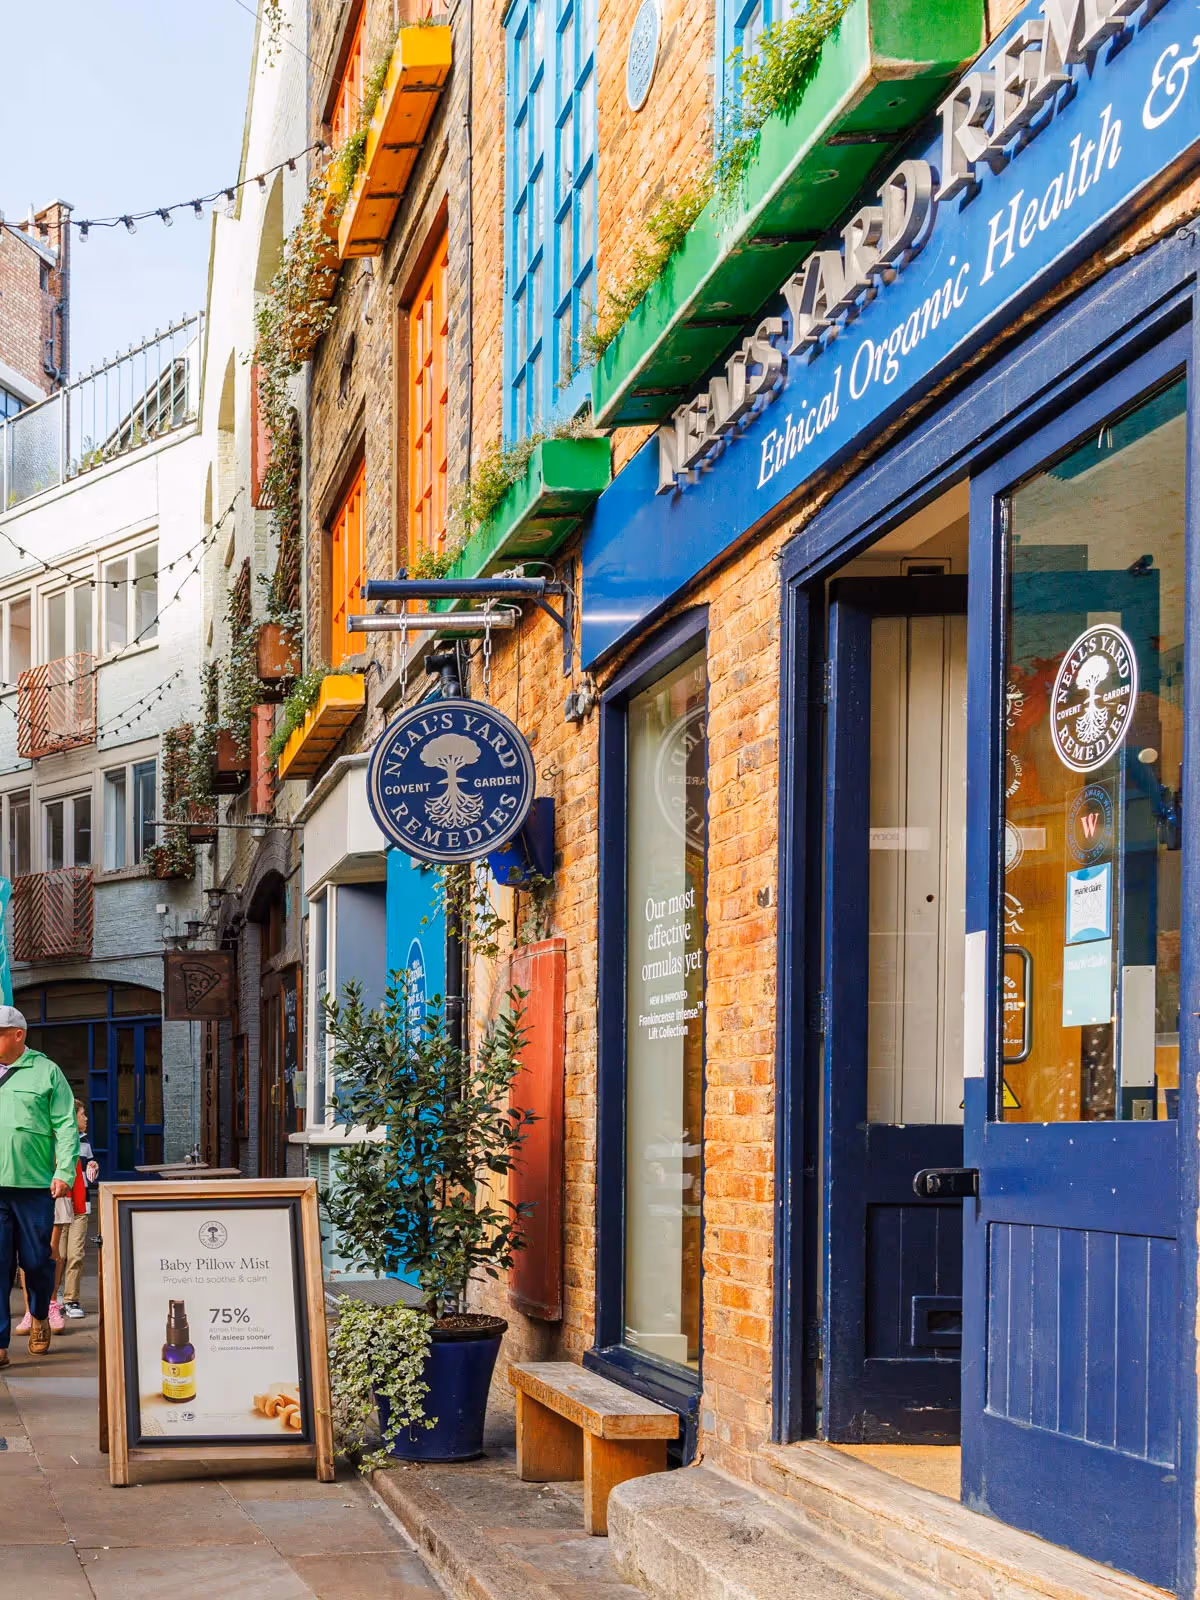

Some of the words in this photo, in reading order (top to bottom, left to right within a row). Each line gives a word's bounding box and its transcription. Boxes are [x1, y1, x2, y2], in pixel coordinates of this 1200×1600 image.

[655, 316, 783, 496] NEAL'S
[780, 160, 931, 356] YARD
[934, 0, 1145, 201] REM
[756, 365, 843, 490] Ethical
[849, 255, 970, 401] Organic
[980, 102, 1123, 286] Health
[1142, 35, 1200, 130] &
[1058, 637, 1097, 704] NEAL'S
[1101, 635, 1130, 678] YARD
[1057, 705, 1082, 721] COVENT
[1102, 684, 1130, 703] GARDEN
[384, 712, 454, 777] NEAL'S
[463, 715, 518, 769] YARD
[1058, 704, 1127, 762] REMEDIES
[384, 783, 431, 796] COVENT
[473, 775, 521, 788] GARDEN
[391, 793, 517, 848] REMEDIES
[1081, 812, 1099, 839] W
[645, 897, 666, 922] Our
[668, 887, 696, 915] most
[1074, 886, 1088, 896] marie
[648, 918, 691, 951] effective
[641, 951, 683, 981] ormulas
[684, 948, 703, 978] yet
[664, 990, 688, 1003] IMPROVED
[639, 1012, 675, 1027] Frankincense
[648, 1027, 658, 1040] Lift
[659, 1024, 688, 1039] Collection
[160, 1258, 192, 1272] Baby
[196, 1258, 236, 1270] Pillow
[240, 1258, 270, 1270] Mist
[238, 1275, 244, 1283] &
[209, 1308, 250, 1324] 75%
